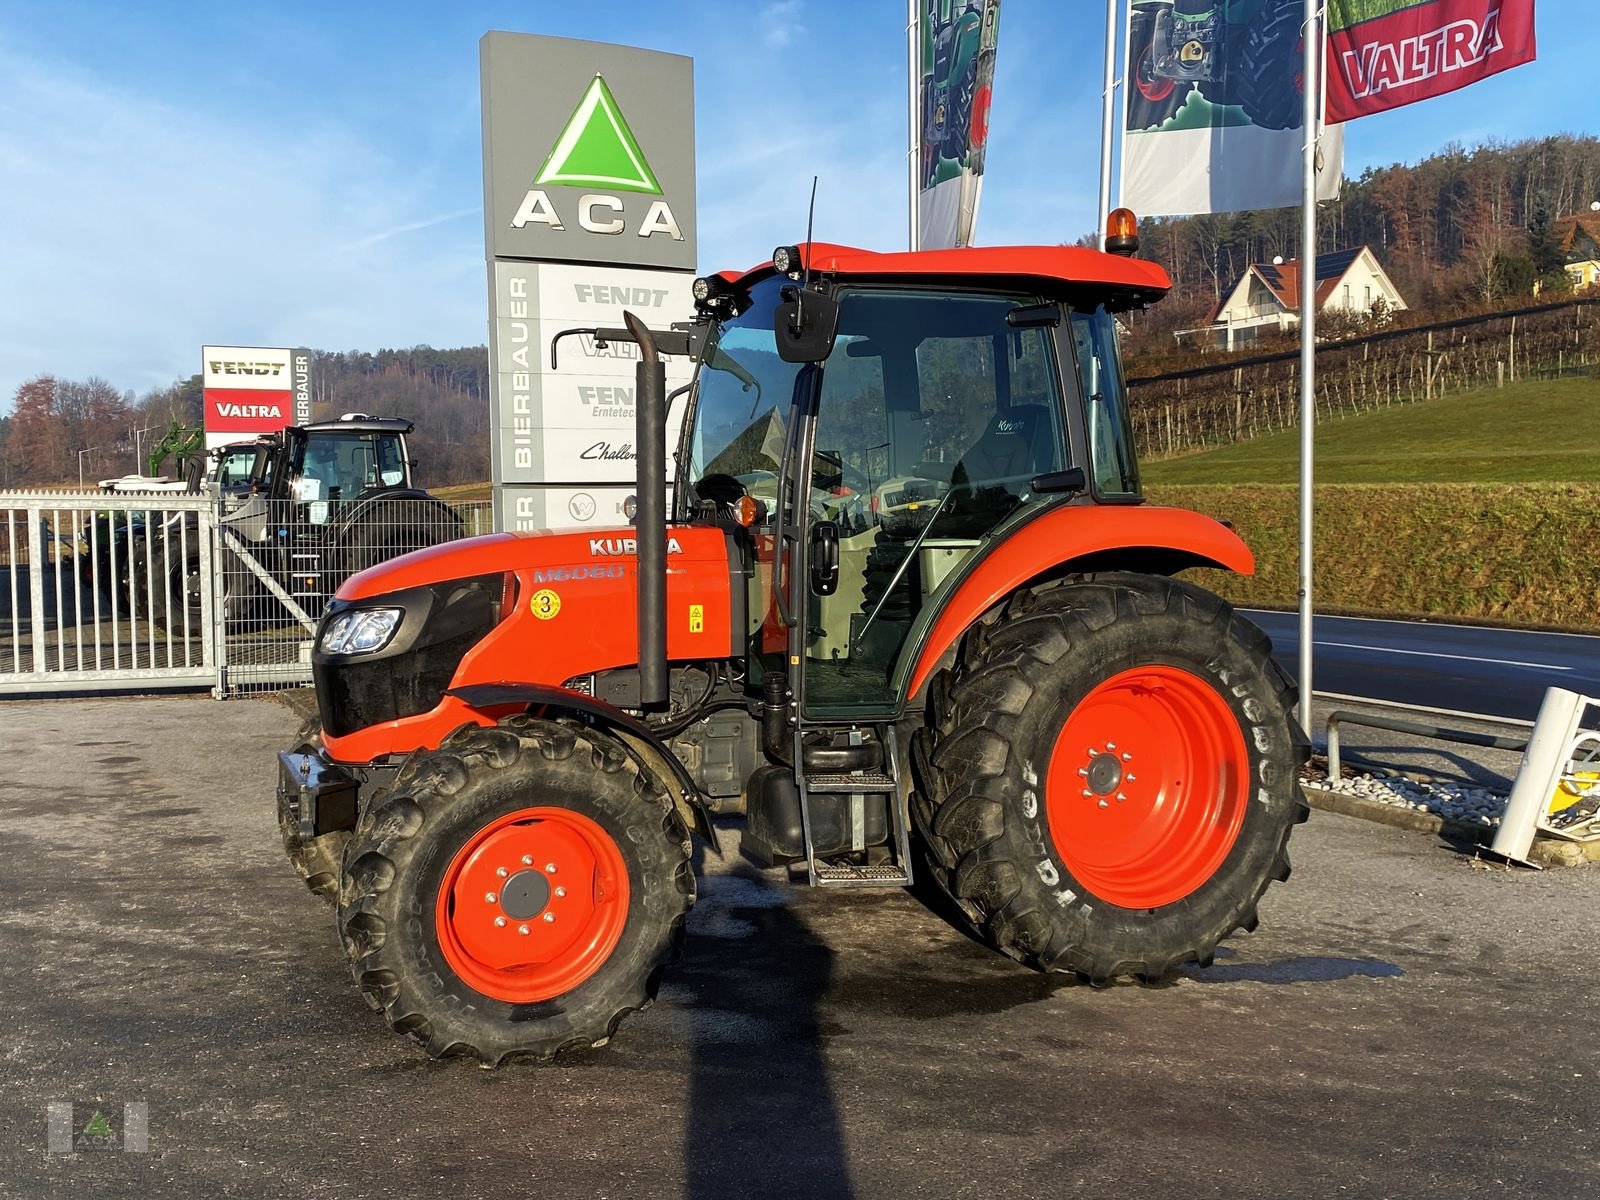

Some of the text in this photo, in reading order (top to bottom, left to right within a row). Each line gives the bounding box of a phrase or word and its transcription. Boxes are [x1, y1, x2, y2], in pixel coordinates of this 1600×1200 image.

[1342, 8, 1504, 99] VALTRA
[510, 190, 685, 241] ACA
[574, 284, 669, 308] FENDT
[578, 334, 672, 363] VALT
[209, 361, 285, 376] FENDT
[509, 277, 532, 469] BIERBAUER
[578, 386, 672, 406] FEN
[216, 402, 282, 418] VALTRA
[592, 406, 636, 418] Erntetec
[580, 441, 637, 460] Challen
[589, 537, 684, 556] KUBA
[541, 595, 551, 613] 3
